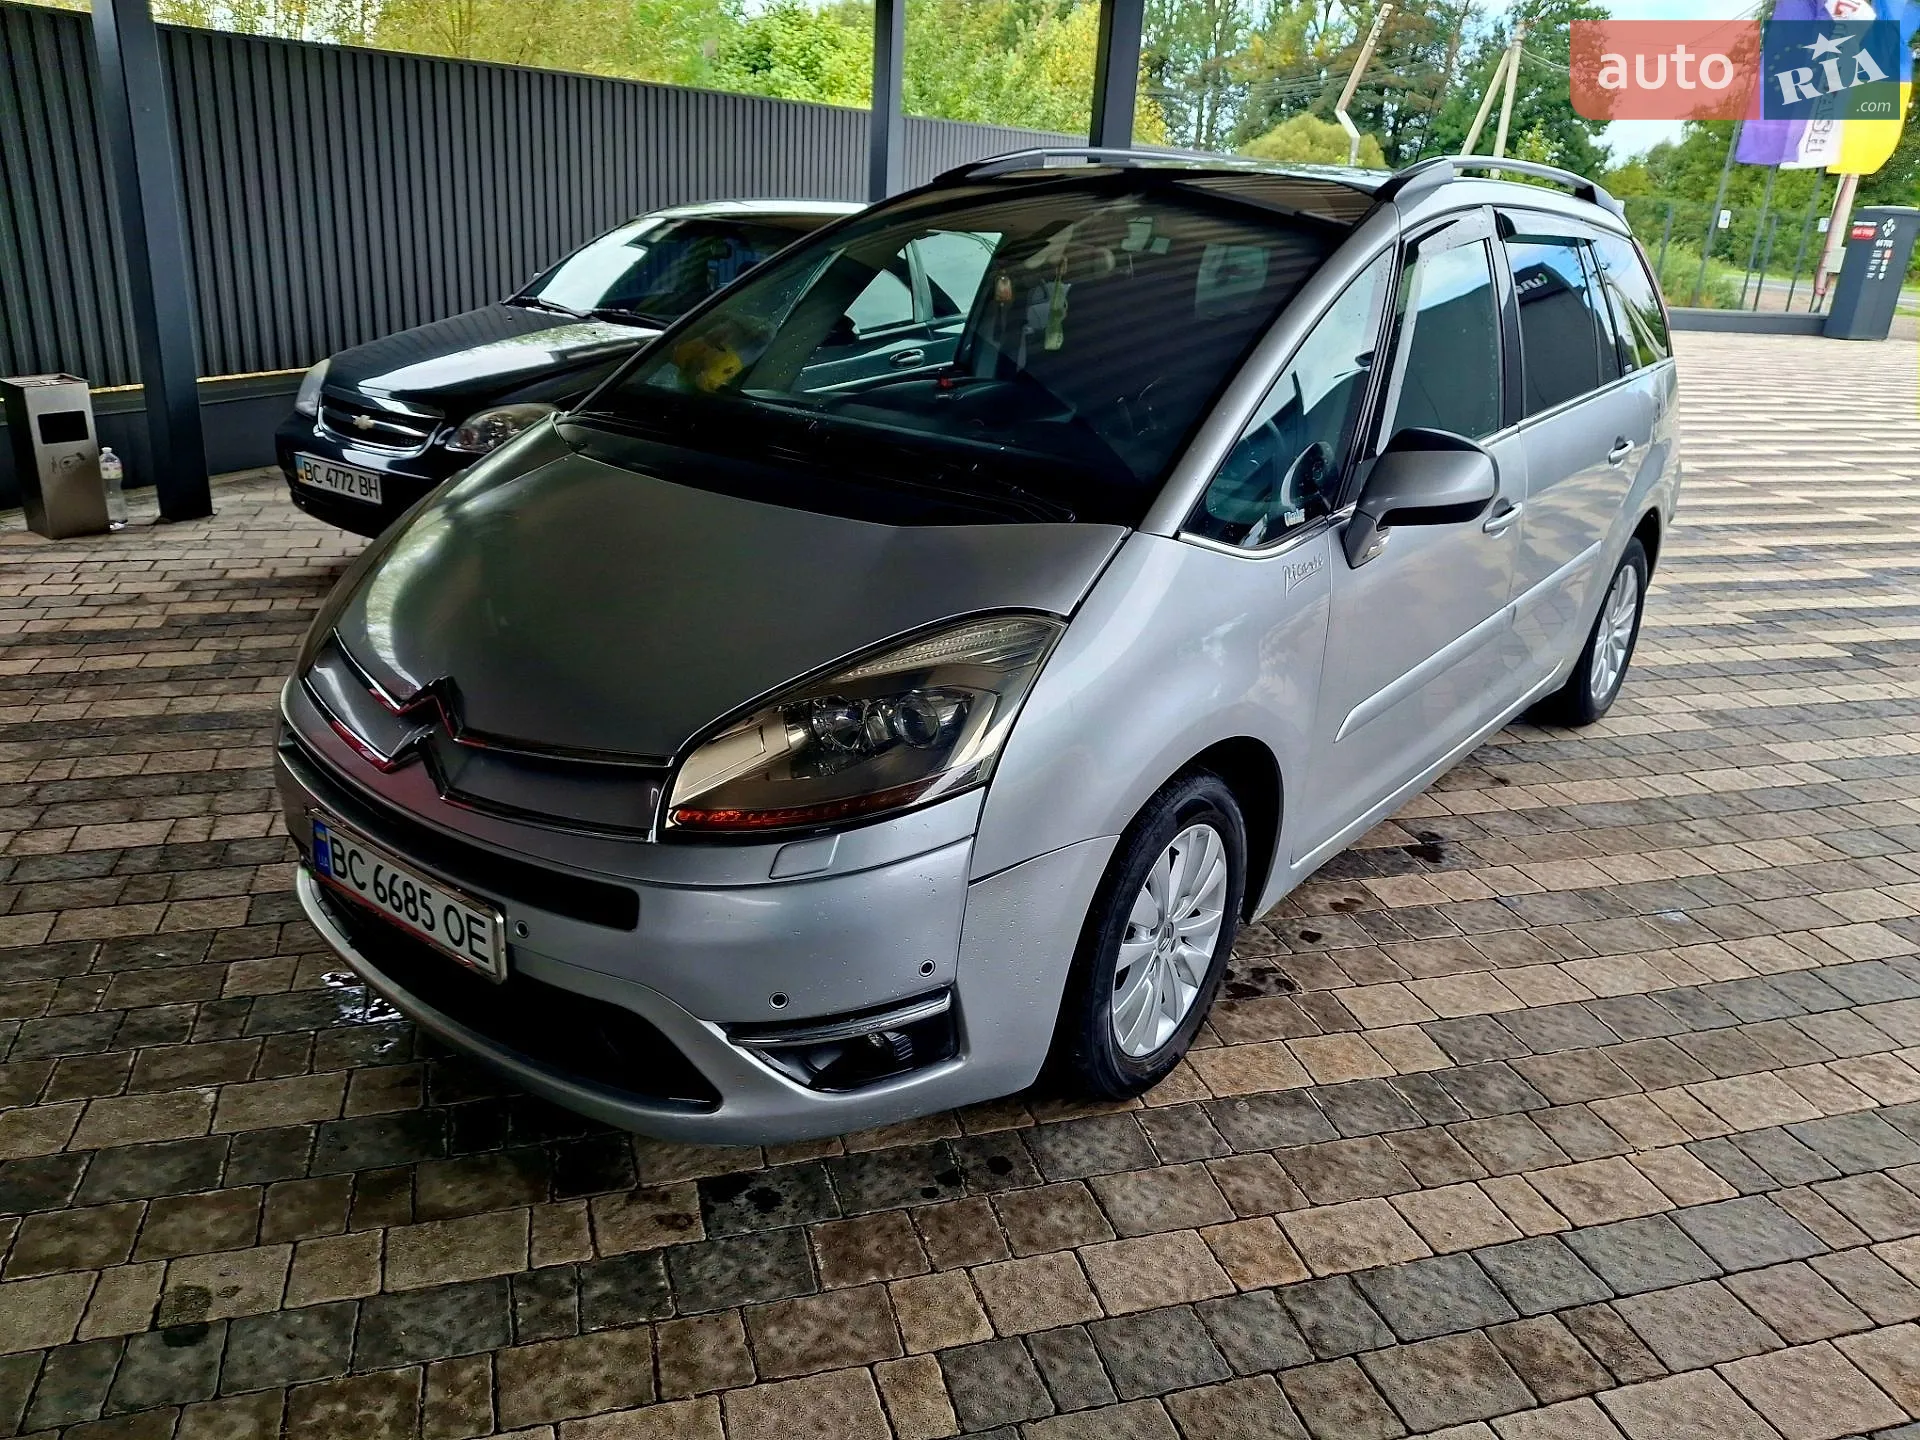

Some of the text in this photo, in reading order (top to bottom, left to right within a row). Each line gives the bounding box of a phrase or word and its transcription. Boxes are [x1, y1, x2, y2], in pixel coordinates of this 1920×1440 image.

[303, 461, 379, 499] BC 4772 BH
[329, 835, 489, 963] BC 6685 OE
